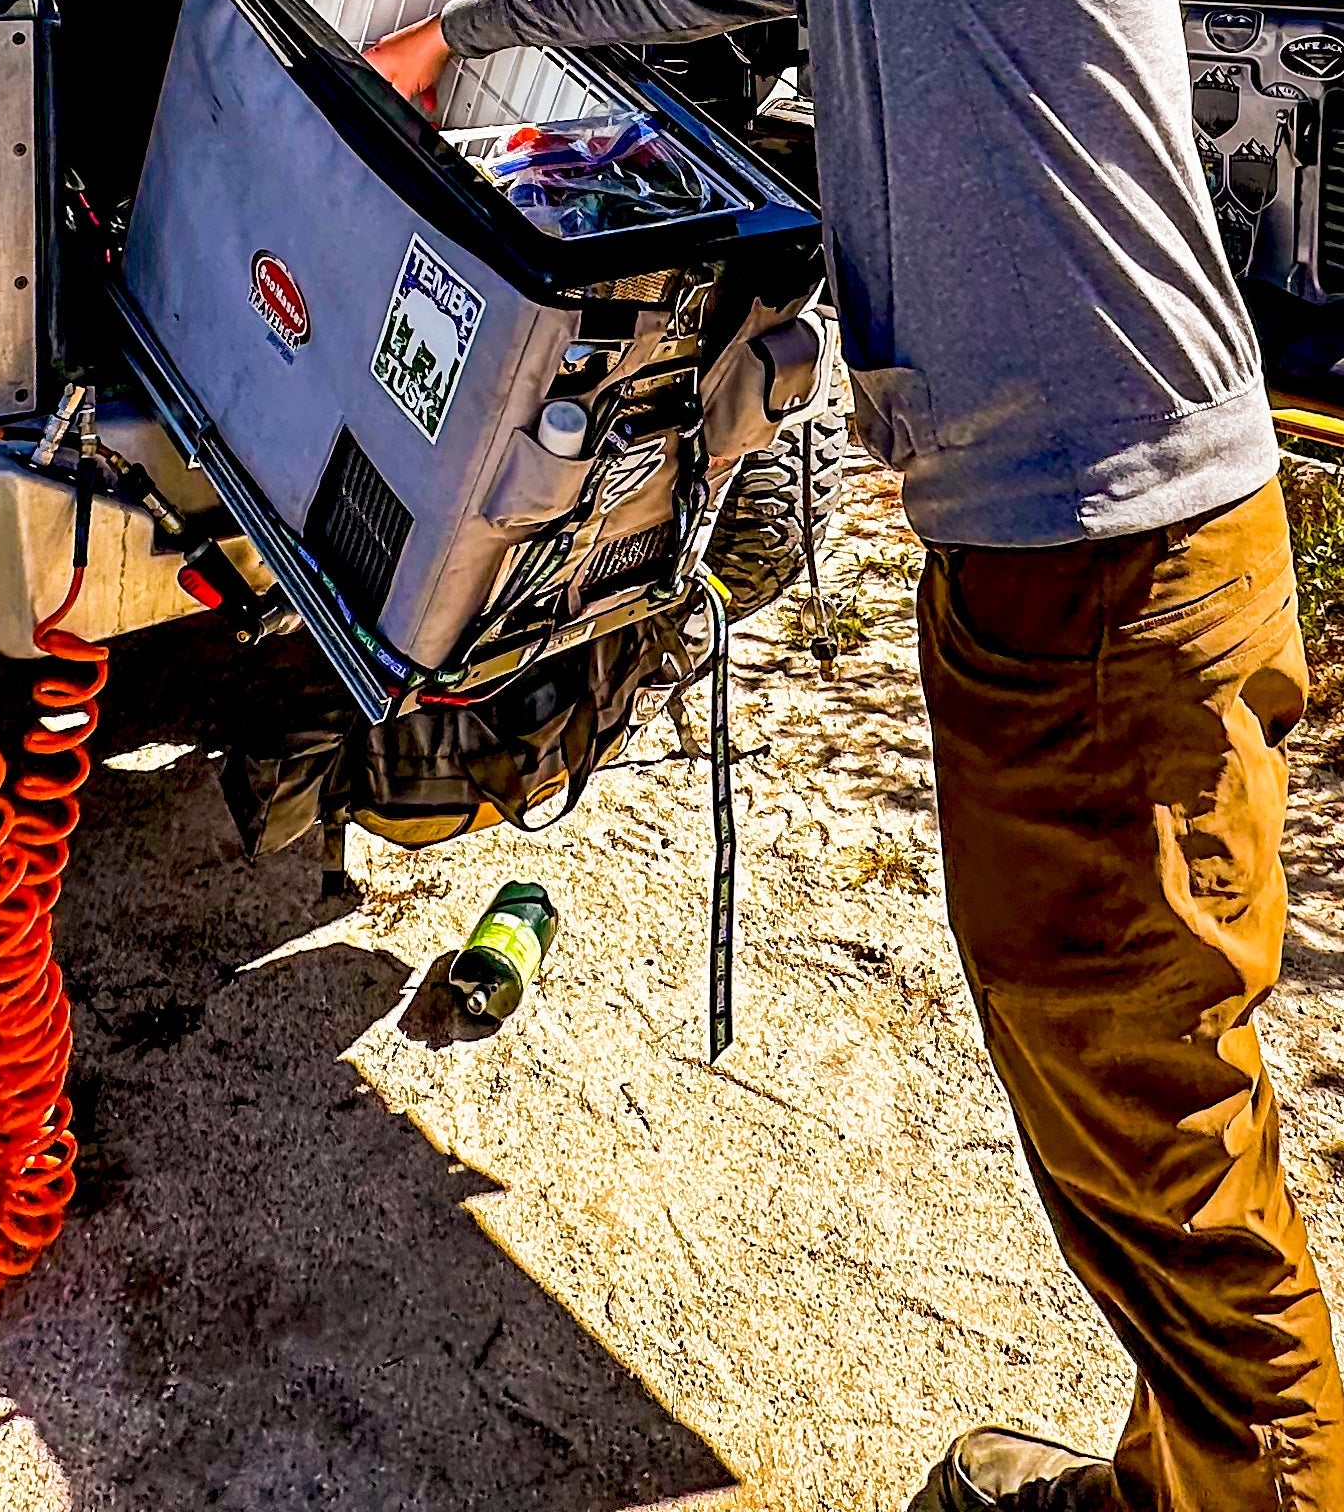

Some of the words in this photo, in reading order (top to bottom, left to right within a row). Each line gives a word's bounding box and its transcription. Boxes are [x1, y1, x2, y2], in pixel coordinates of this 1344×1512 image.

[1288, 41, 1321, 53] SAFE
[410, 246, 478, 328] TEMBO
[385, 351, 436, 426] TUSK
